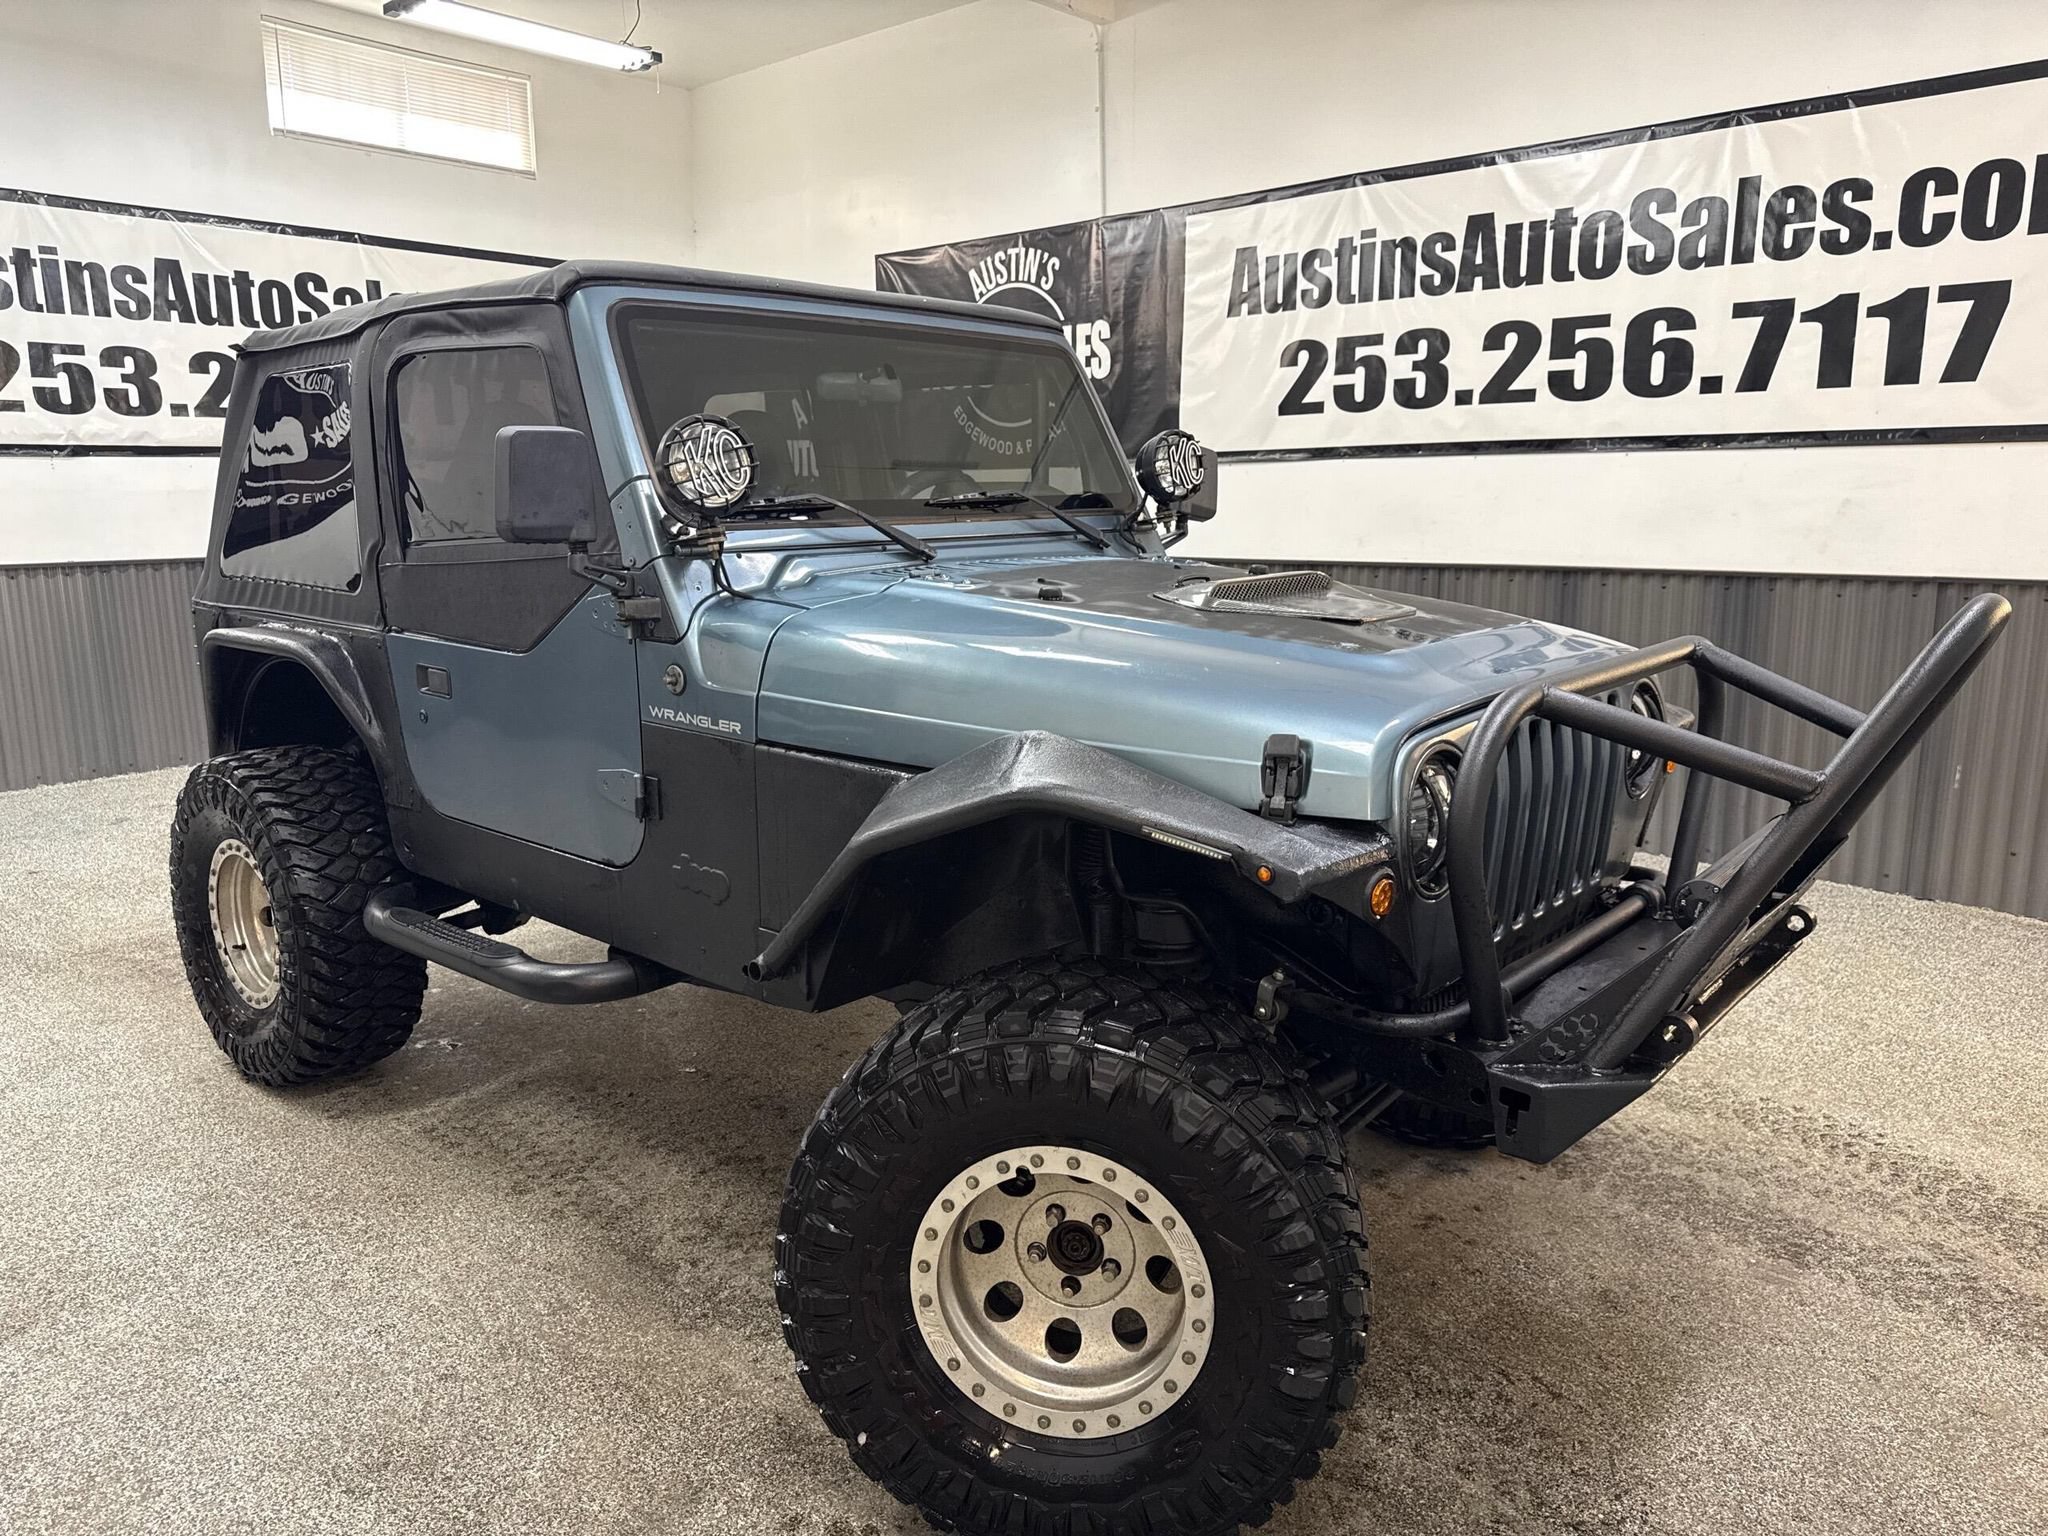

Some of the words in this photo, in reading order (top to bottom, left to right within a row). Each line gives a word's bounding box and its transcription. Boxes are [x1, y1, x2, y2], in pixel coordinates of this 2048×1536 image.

[1227, 153, 2048, 318] AustinsAutoSales.co
[0, 245, 402, 330] tinsAutoS
[968, 247, 1060, 301] AUSTIN'S
[1278, 279, 2012, 416] 253.256.7117
[953, 405, 1013, 455] EDGEWOOD
[684, 427, 750, 499] KC
[1169, 437, 1204, 489] KC
[648, 704, 742, 735] WRANGLER
